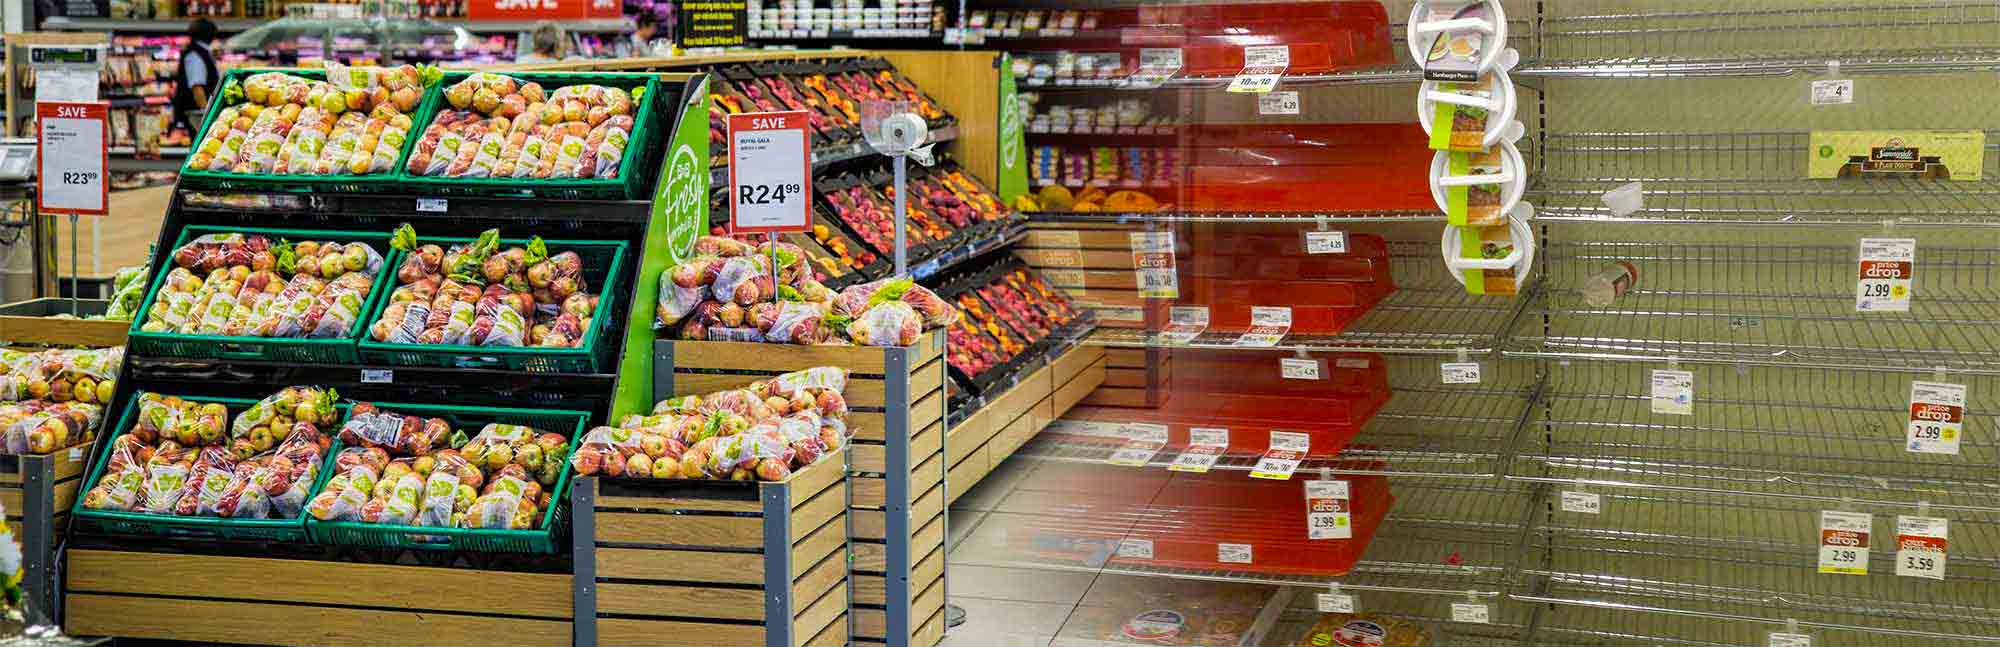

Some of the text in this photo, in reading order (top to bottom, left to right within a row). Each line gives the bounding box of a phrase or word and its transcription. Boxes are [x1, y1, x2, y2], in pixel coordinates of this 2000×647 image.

[57, 106, 87, 118] SAVE
[752, 117, 785, 129] SAVE
[1140, 255, 1167, 269] drop
[1866, 263, 1901, 278] drop
[1864, 284, 1890, 297] 2.99
[1917, 406, 1951, 423] drop
[1915, 426, 1940, 439] 2.99
[1313, 502, 1341, 513] drop
[1314, 516, 1335, 528] 2.99
[1827, 533, 1860, 546] drop
[1832, 550, 1856, 562] 2.99
[1907, 556, 1934, 571] 3.59
